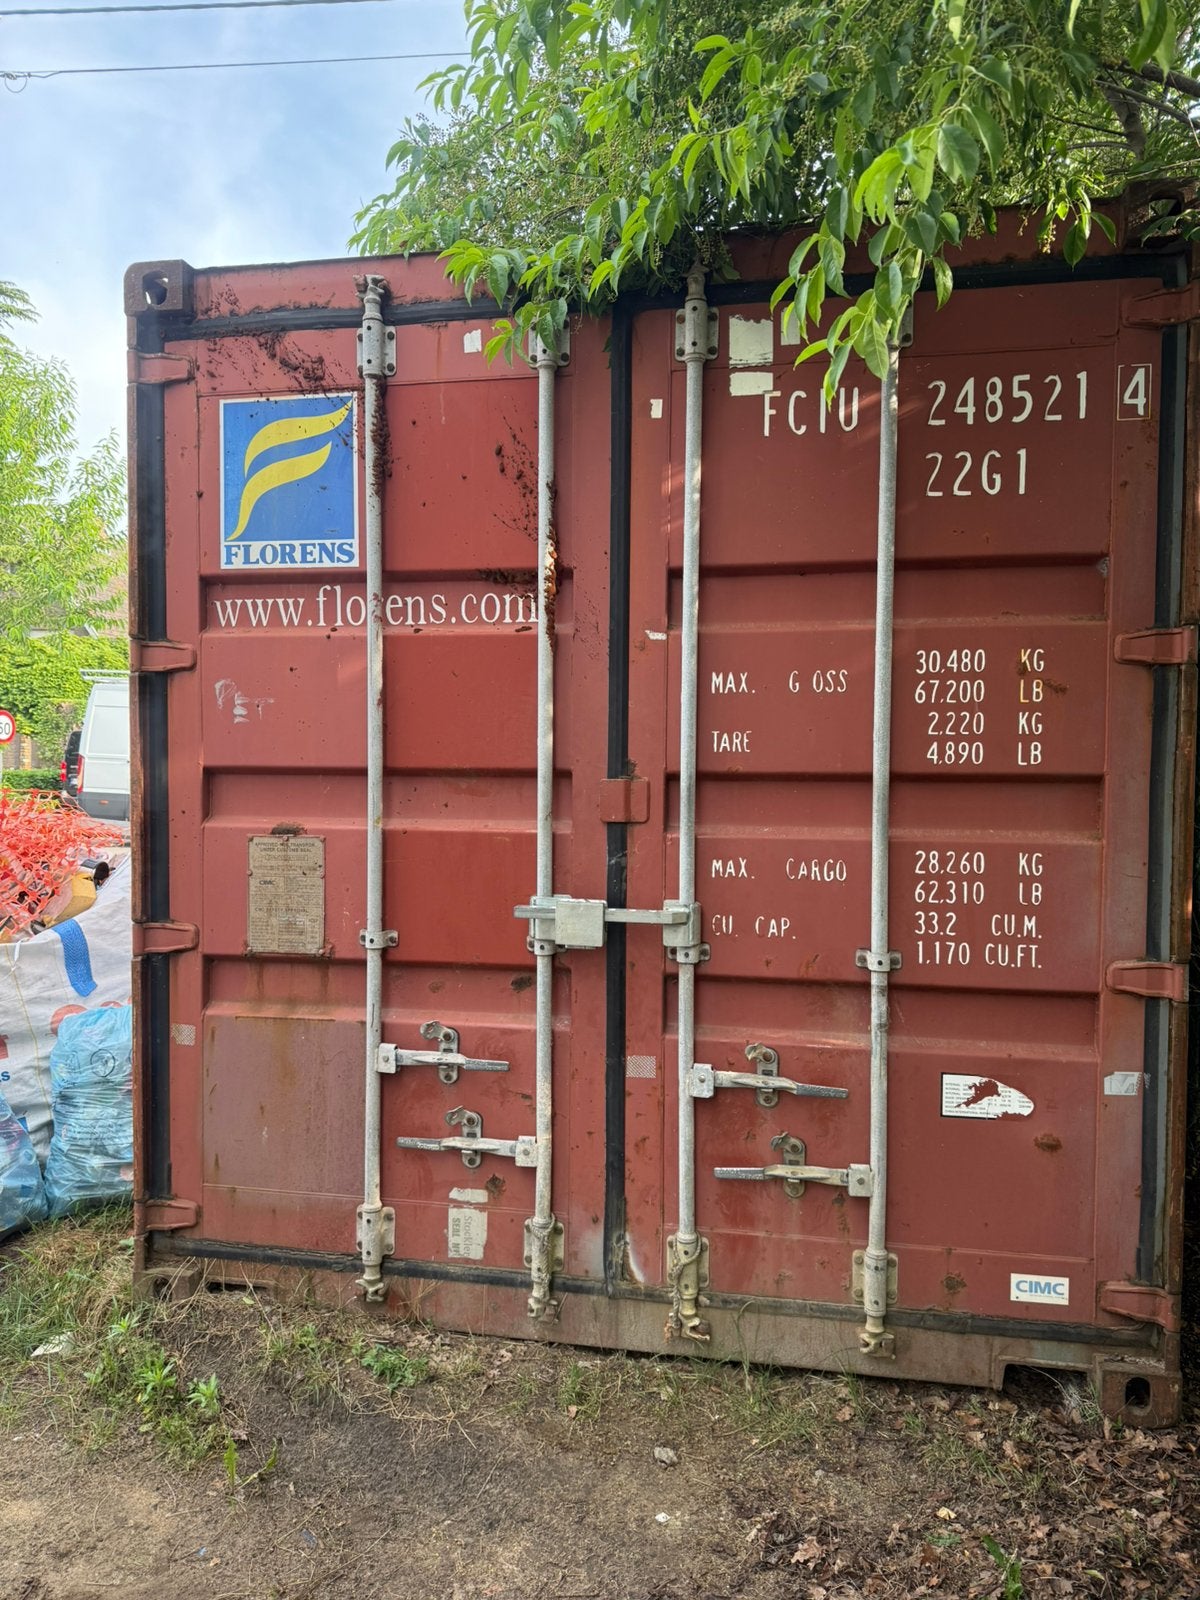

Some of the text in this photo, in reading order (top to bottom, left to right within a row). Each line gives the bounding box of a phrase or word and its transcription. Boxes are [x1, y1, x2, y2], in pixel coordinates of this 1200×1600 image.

[763, 367, 1147, 437] FCIU 248521 4
[925, 448, 1027, 497] 22G1
[224, 542, 355, 566] FLORENS
[214, 584, 539, 628] www.floens.com
[915, 648, 1045, 674] 30,480 KG
[711, 671, 756, 694] MAX.
[914, 679, 1044, 704] 67,200 LB
[927, 711, 1043, 736] 2,220 KG
[711, 730, 752, 753] TARE
[926, 741, 1042, 766] 4,890 LB
[711, 857, 847, 882] MAX. CARGO
[914, 850, 1043, 876] 28,260 KG
[914, 880, 1042, 905] 62,310 LB
[712, 914, 796, 940] CU. CAP.
[914, 910, 1042, 939] 33.2 CU.M.
[916, 940, 1042, 969] 1,170 CU.FT.
[1015, 1279, 1065, 1296] CIMC
